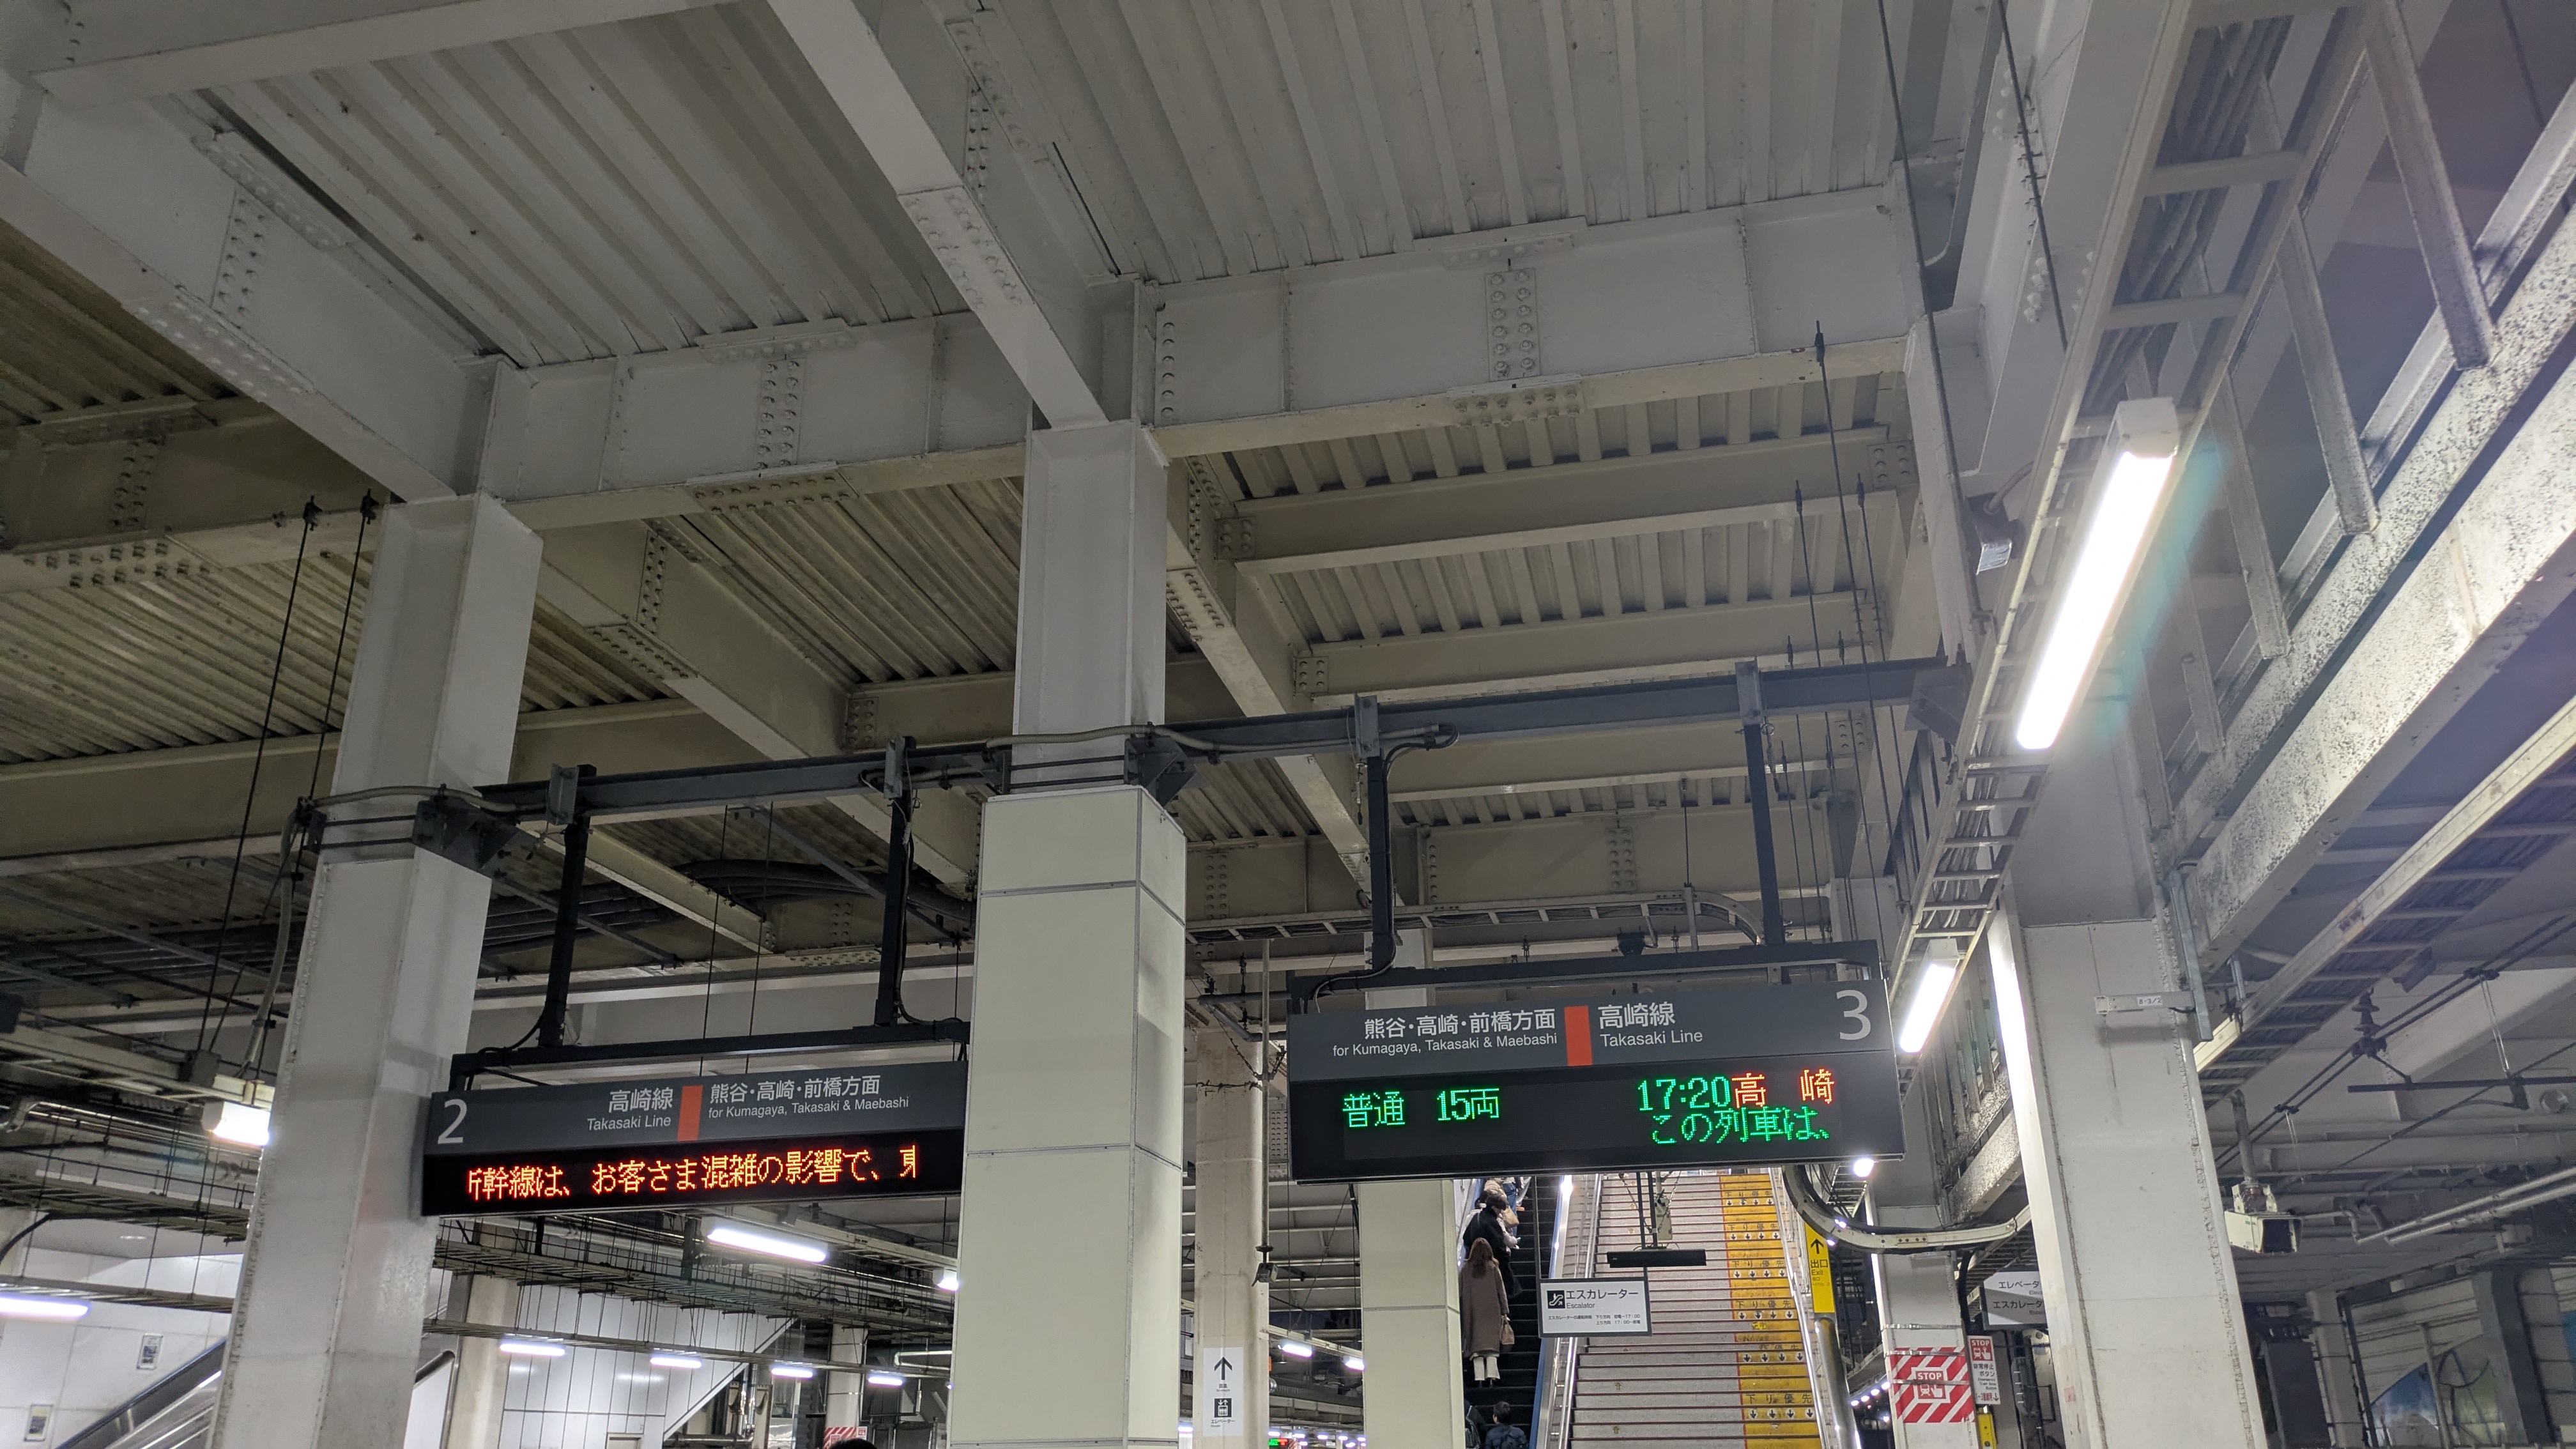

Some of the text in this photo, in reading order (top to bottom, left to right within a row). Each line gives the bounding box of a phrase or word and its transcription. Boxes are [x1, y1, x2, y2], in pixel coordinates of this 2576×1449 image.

[1597, 1000, 1676, 1030] 高崎線
[1835, 989, 1872, 1041] 3
[1333, 1032, 1558, 1057] for Kumagaya, Takasaki & Maebashi
[1600, 1029, 1703, 1048] Takasaki Line
[608, 1087, 673, 1113] 高崎線
[1637, 1075, 1731, 1112] 17:20
[708, 1096, 910, 1119] for Kumagaya, Takasaki & Maebashi
[1342, 1087, 1500, 1128] 普通 15両
[437, 1098, 468, 1145] 2
[587, 1114, 671, 1131] Takasaki Line
[1811, 1259, 1828, 1268] 出口
[1566, 1289, 1639, 1300] エスカレーター
[1917, 1372, 1942, 1380] STOP
[1745, 1393, 1812, 1404] 下り優先
